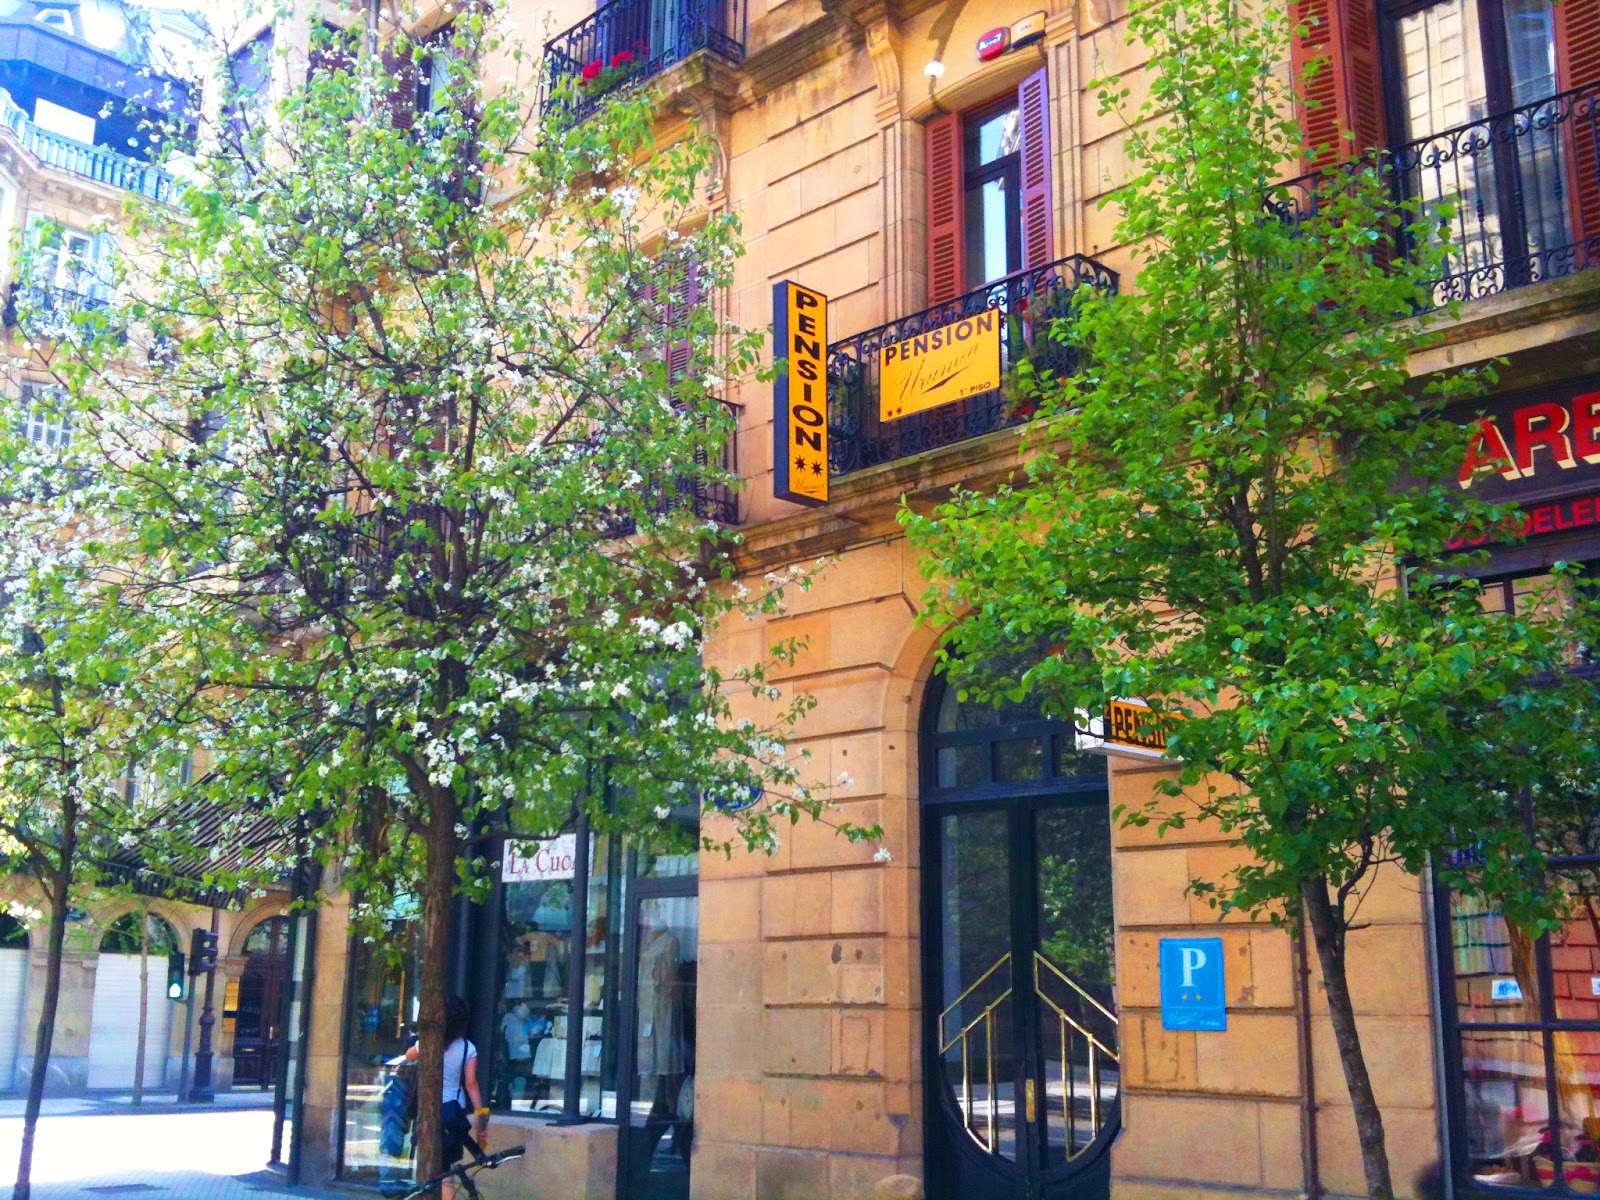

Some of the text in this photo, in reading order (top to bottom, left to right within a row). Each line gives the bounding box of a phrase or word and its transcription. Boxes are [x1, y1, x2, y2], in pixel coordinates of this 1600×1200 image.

[885, 313, 993, 367] PENSION
[793, 290, 823, 452] PENSION
[970, 381, 991, 393] PISO
[1179, 948, 1207, 986] P
